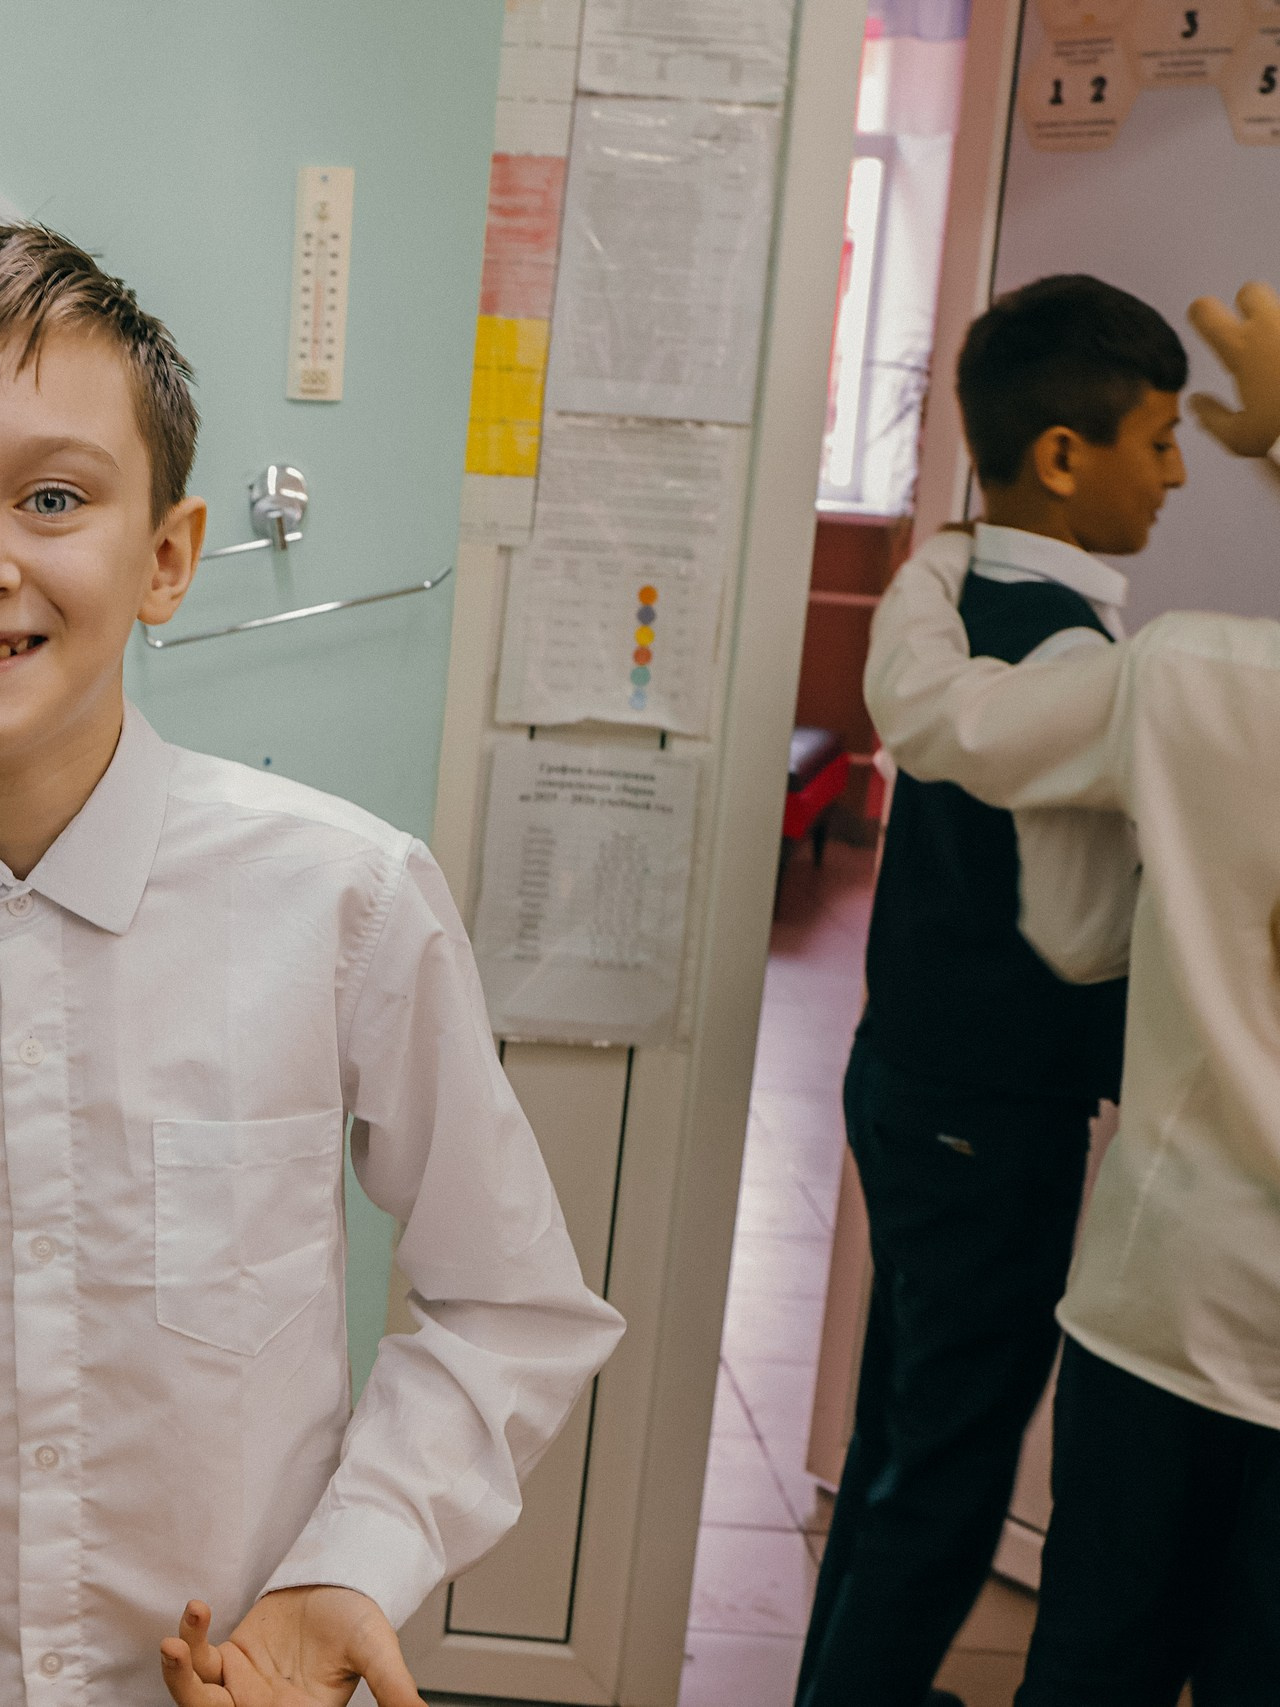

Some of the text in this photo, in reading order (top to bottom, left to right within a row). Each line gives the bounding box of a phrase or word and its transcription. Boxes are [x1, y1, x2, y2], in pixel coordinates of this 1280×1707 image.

[1049, 75, 1108, 106] 1 2
[1258, 65, 1278, 94] 5
